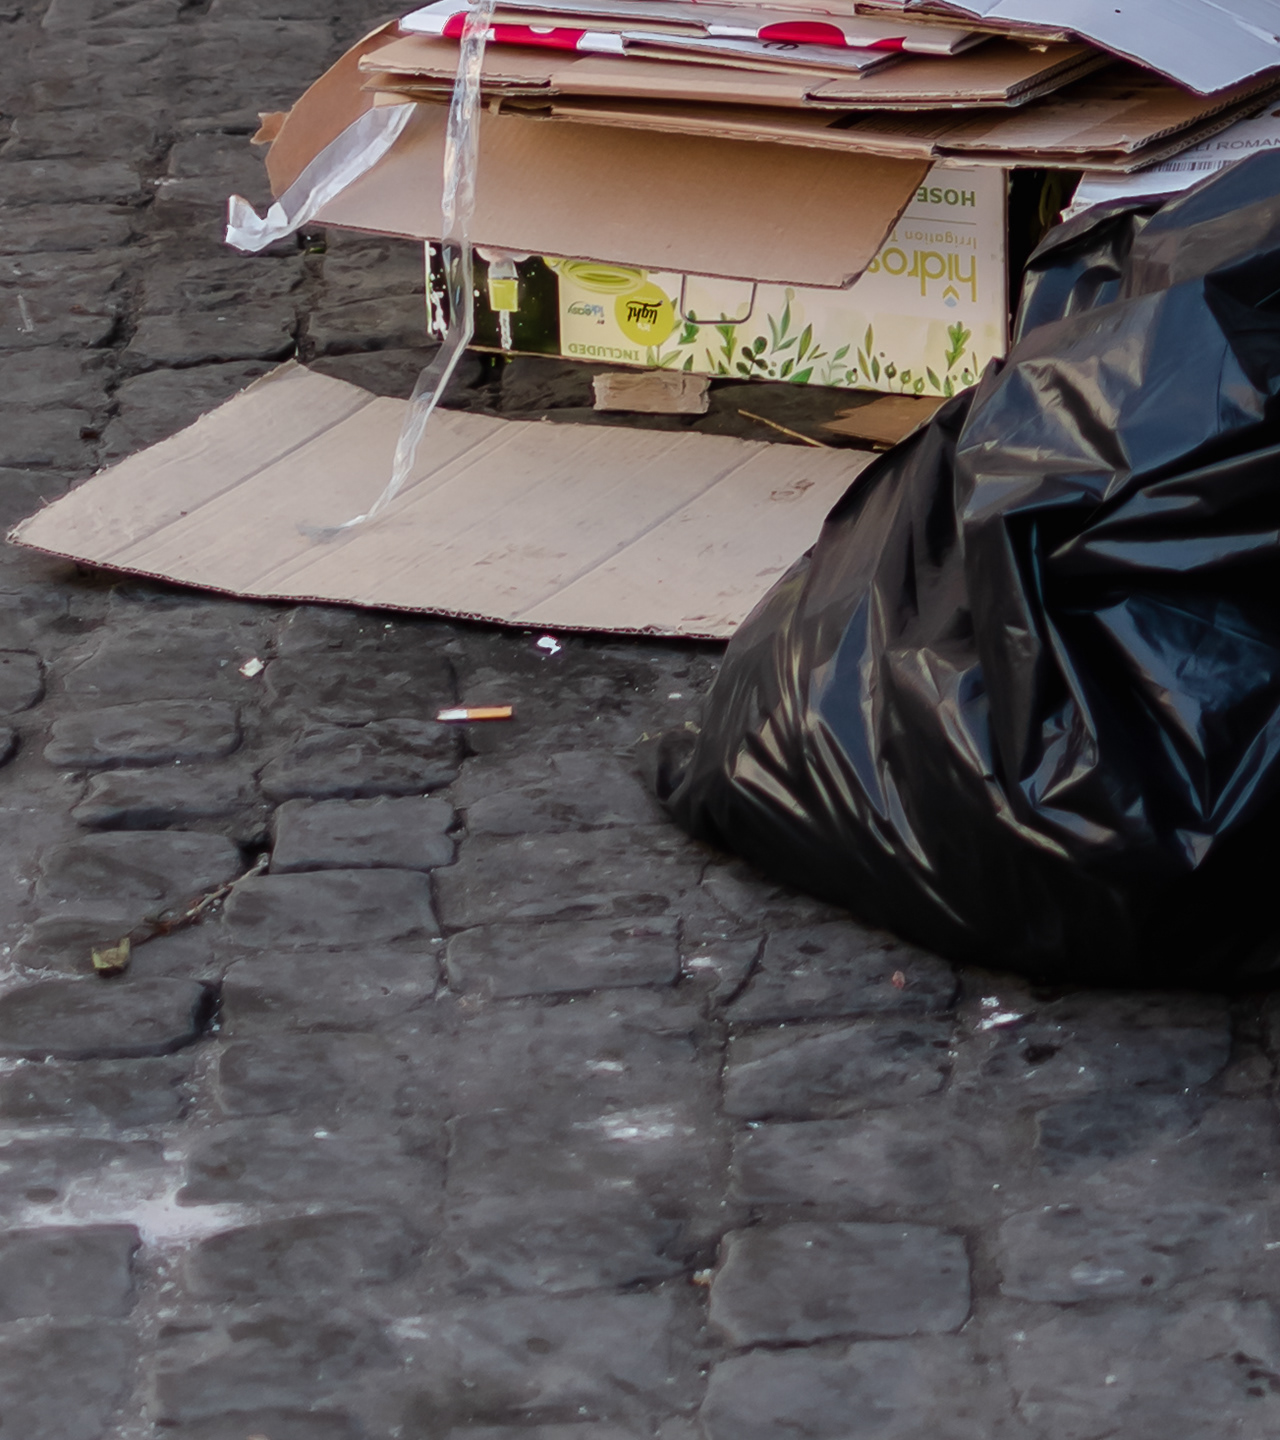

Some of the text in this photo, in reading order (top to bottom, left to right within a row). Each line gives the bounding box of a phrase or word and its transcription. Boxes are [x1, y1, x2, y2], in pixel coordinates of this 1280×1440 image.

[904, 230, 977, 250] Irrigation
[626, 300, 663, 325] light
[568, 342, 640, 362] INCLUDED
